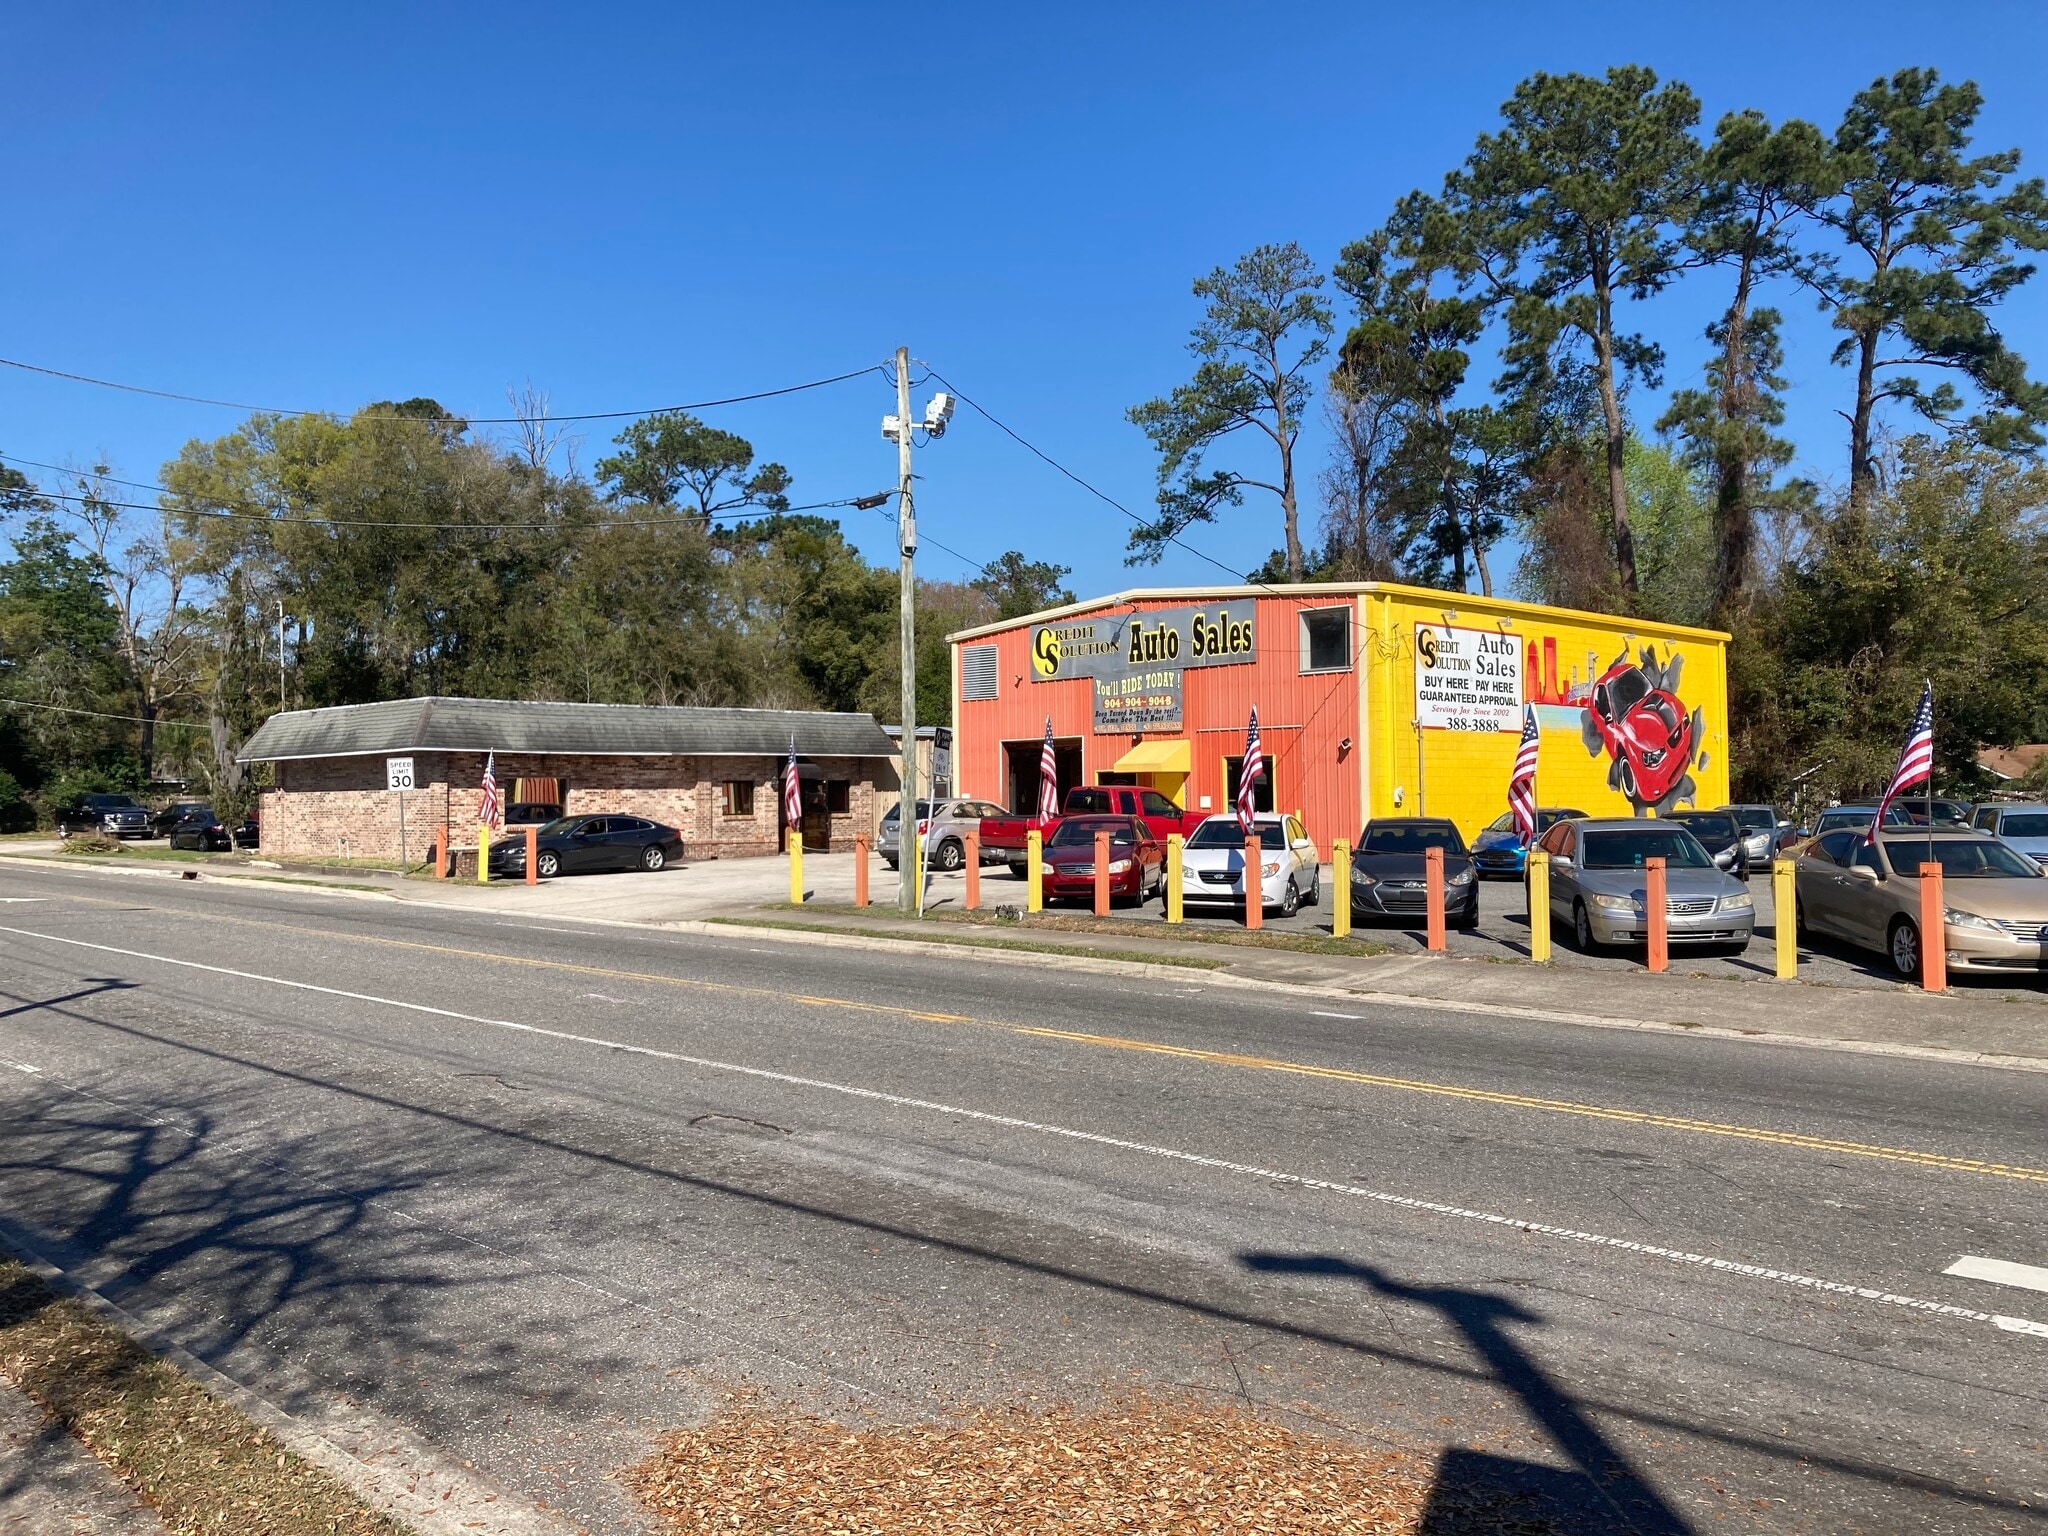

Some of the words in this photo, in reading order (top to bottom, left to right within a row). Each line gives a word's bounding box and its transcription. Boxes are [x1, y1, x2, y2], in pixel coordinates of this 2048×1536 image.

[1128, 620, 1180, 664] Auto
[1192, 610, 1253, 658] Sales
[1478, 634, 1514, 655] Auto
[1476, 655, 1516, 678] Sales
[1096, 679, 1118, 696] You'll
[1121, 675, 1143, 695] RIDE
[1145, 671, 1175, 689] TODAY
[1424, 675, 1443, 688] BUY
[1446, 677, 1469, 690] HERE
[1475, 680, 1490, 692] PAY
[1492, 681, 1514, 693] HERE
[1419, 690, 1477, 704] GUARANTEED
[1478, 694, 1518, 707] APPROVAL
[1095, 710, 1108, 718] Been
[1109, 709, 1127, 717] Turned
[1145, 708, 1153, 716] By
[1150, 714, 1164, 722] Best
[1431, 704, 1457, 715] Serving
[1459, 706, 1470, 715] Jax
[1474, 707, 1491, 715] Since
[1493, 708, 1510, 717] 2002
[1446, 717, 1500, 732] 388-3888
[392, 776, 411, 787] 30
